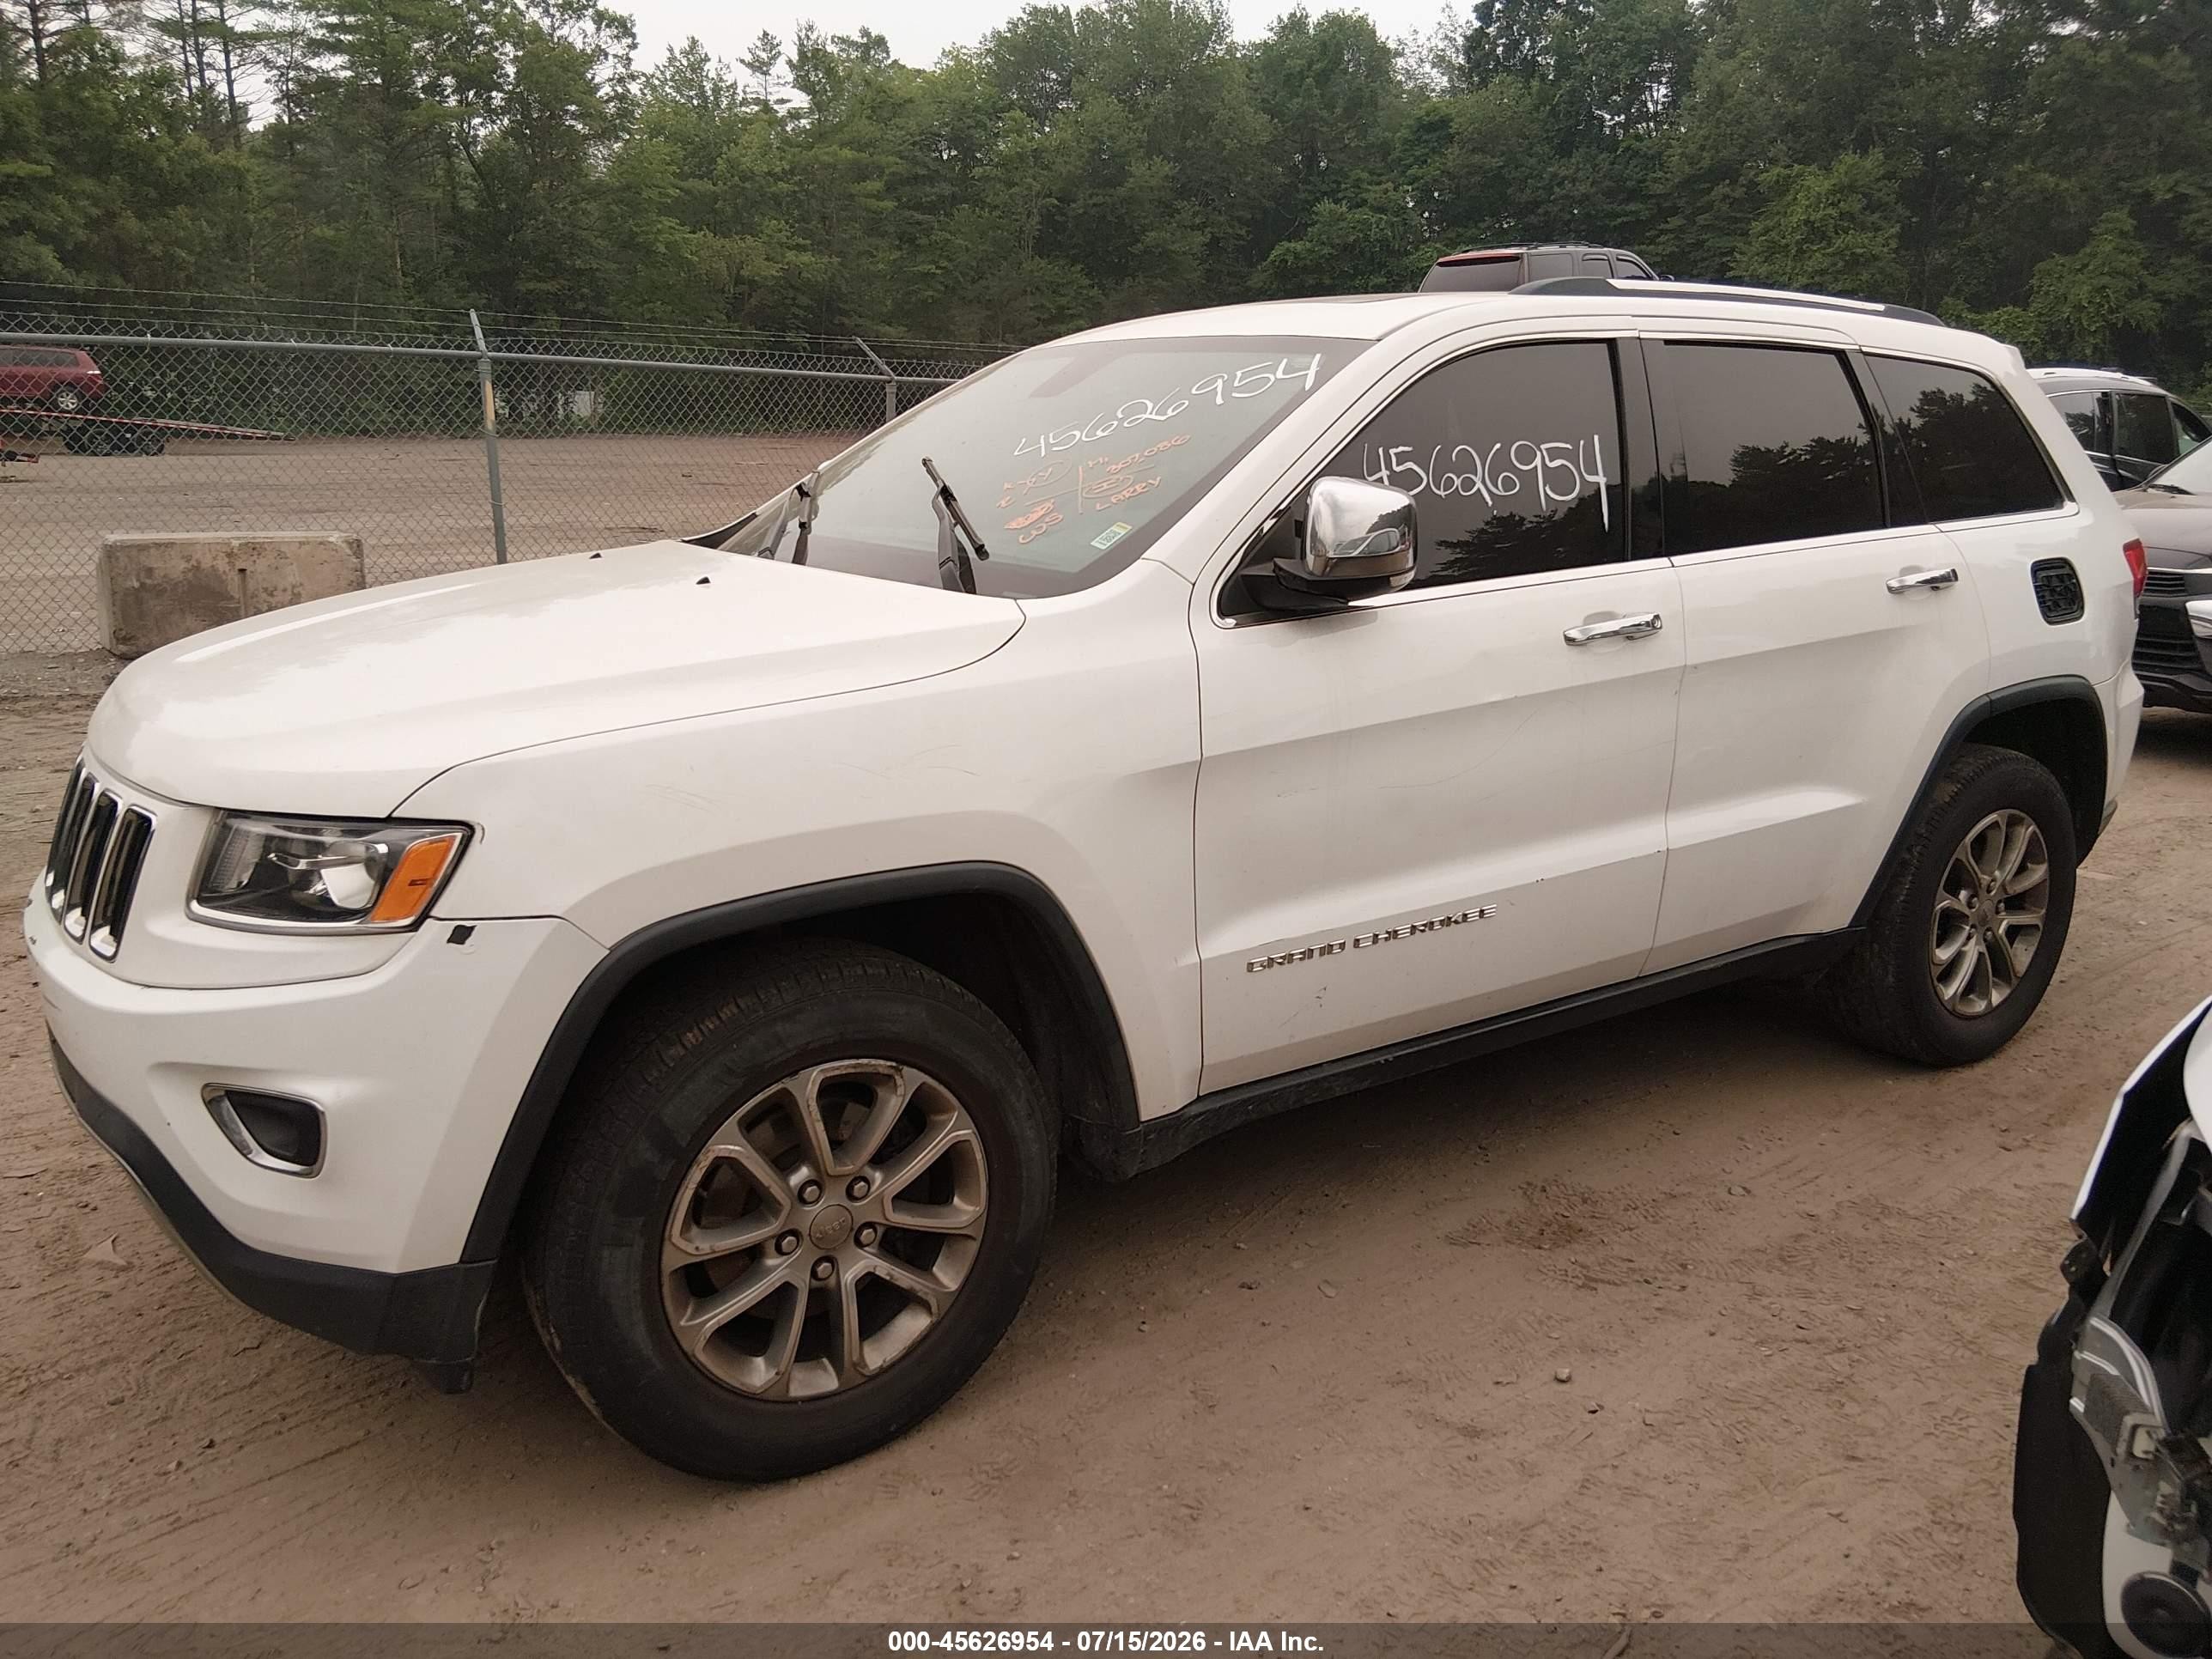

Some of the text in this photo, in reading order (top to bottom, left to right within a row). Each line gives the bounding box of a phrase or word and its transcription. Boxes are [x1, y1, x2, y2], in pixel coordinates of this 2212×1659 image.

[1013, 353, 1322, 458] 45626954
[1363, 434, 1609, 533] 45626954
[1247, 904, 1498, 972] GRAND CHEROKEE
